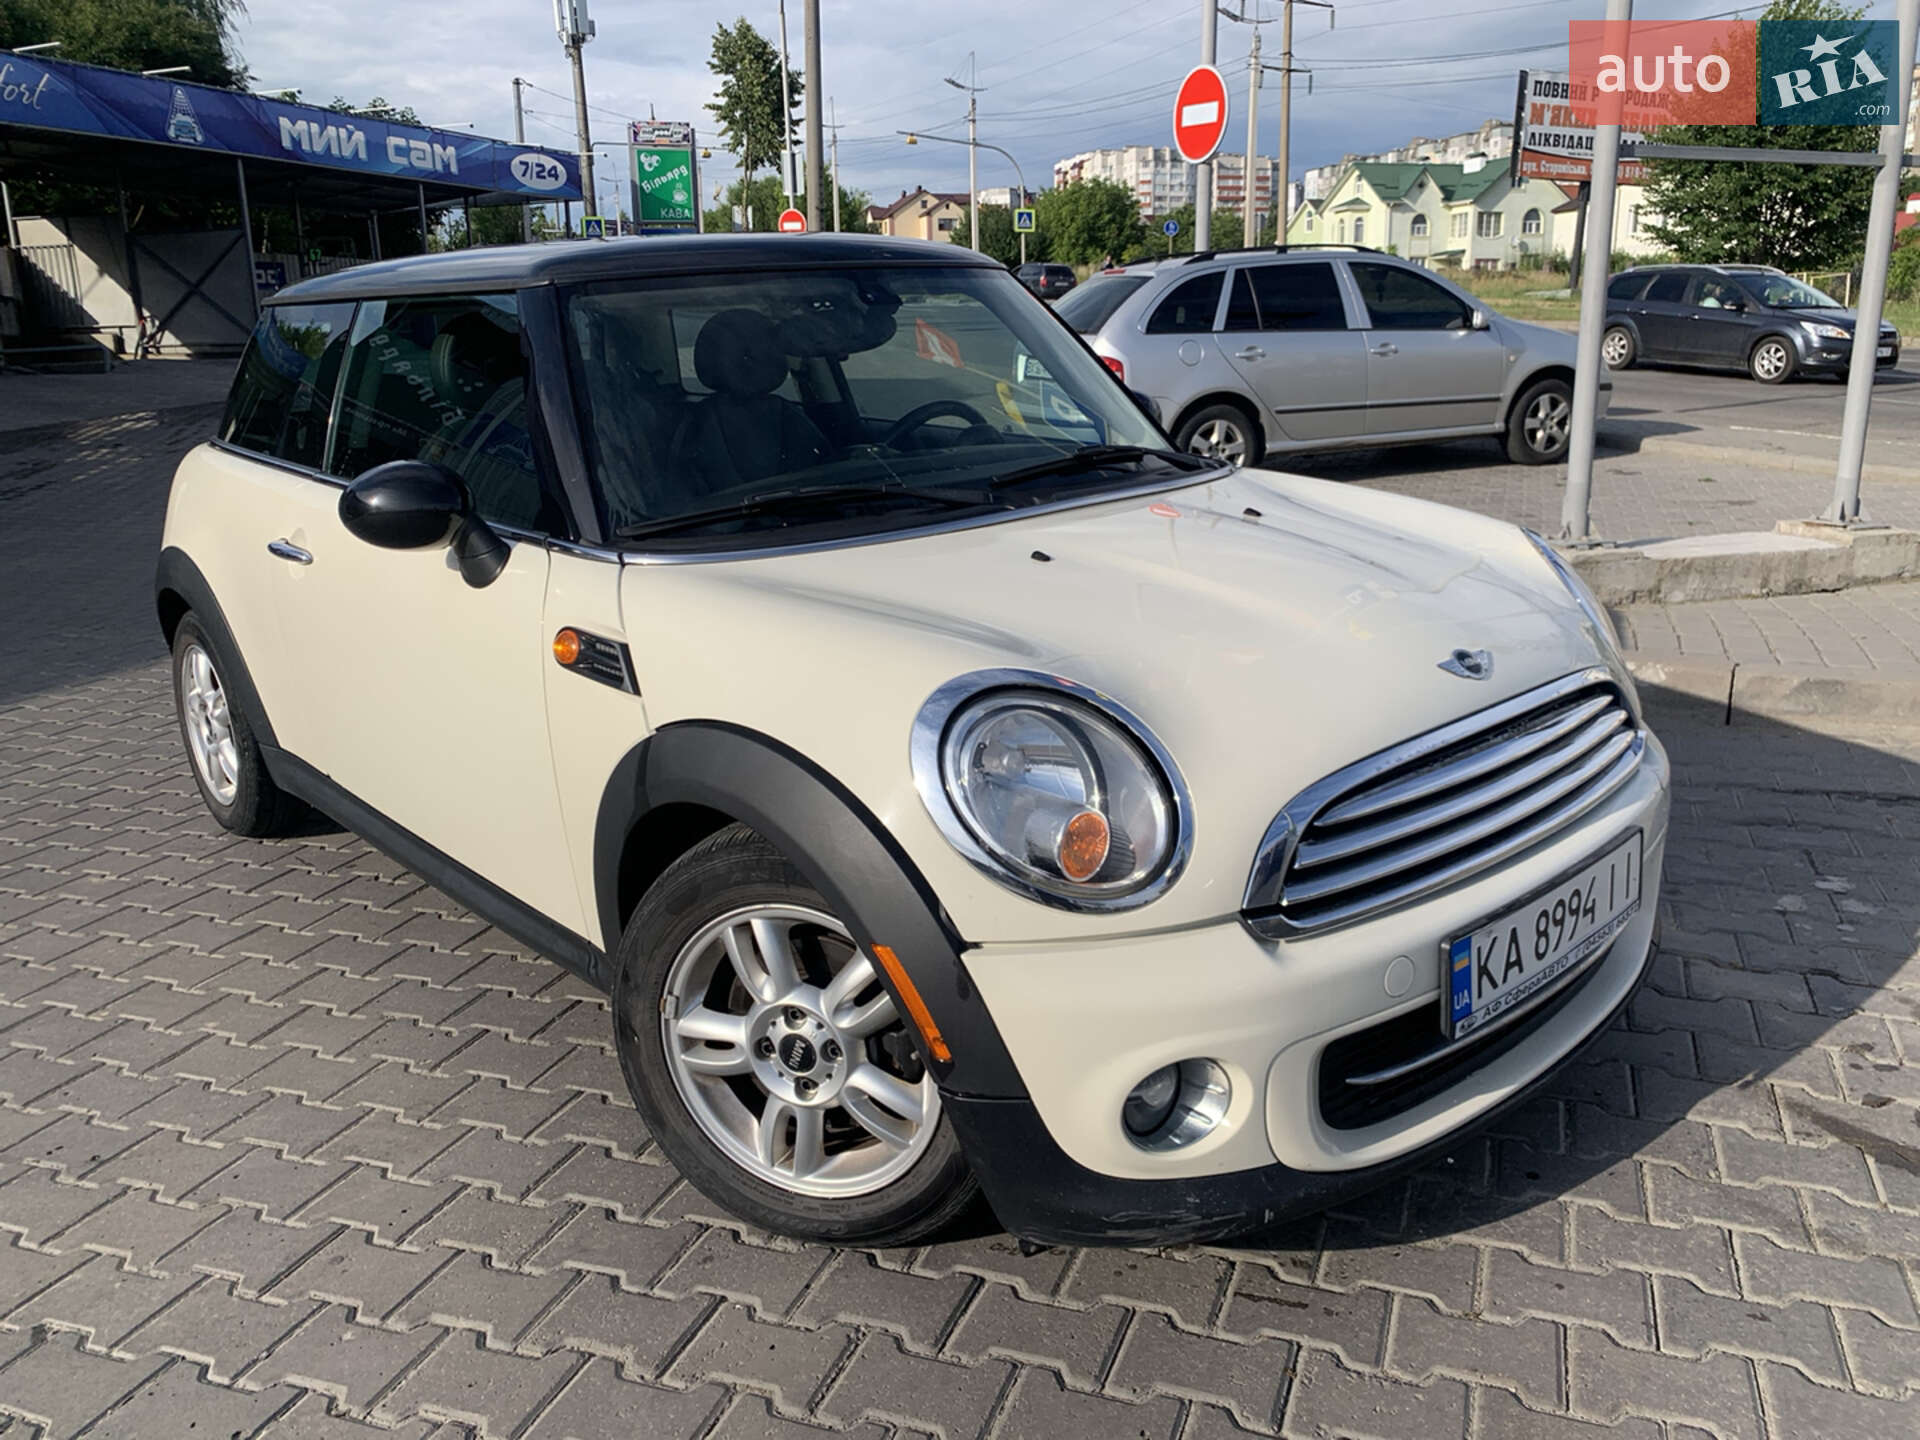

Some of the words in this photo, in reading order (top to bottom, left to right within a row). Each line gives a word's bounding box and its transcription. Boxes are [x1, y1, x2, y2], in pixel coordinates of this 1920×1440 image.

[1528, 131, 1595, 151] ЛІКВІДАЦ
[660, 207, 691, 219] КАВА
[1476, 927, 1525, 999] KA
[1535, 875, 1597, 961] 8994
[1454, 989, 1471, 1011] UA
[788, 1039, 807, 1070] MINI
